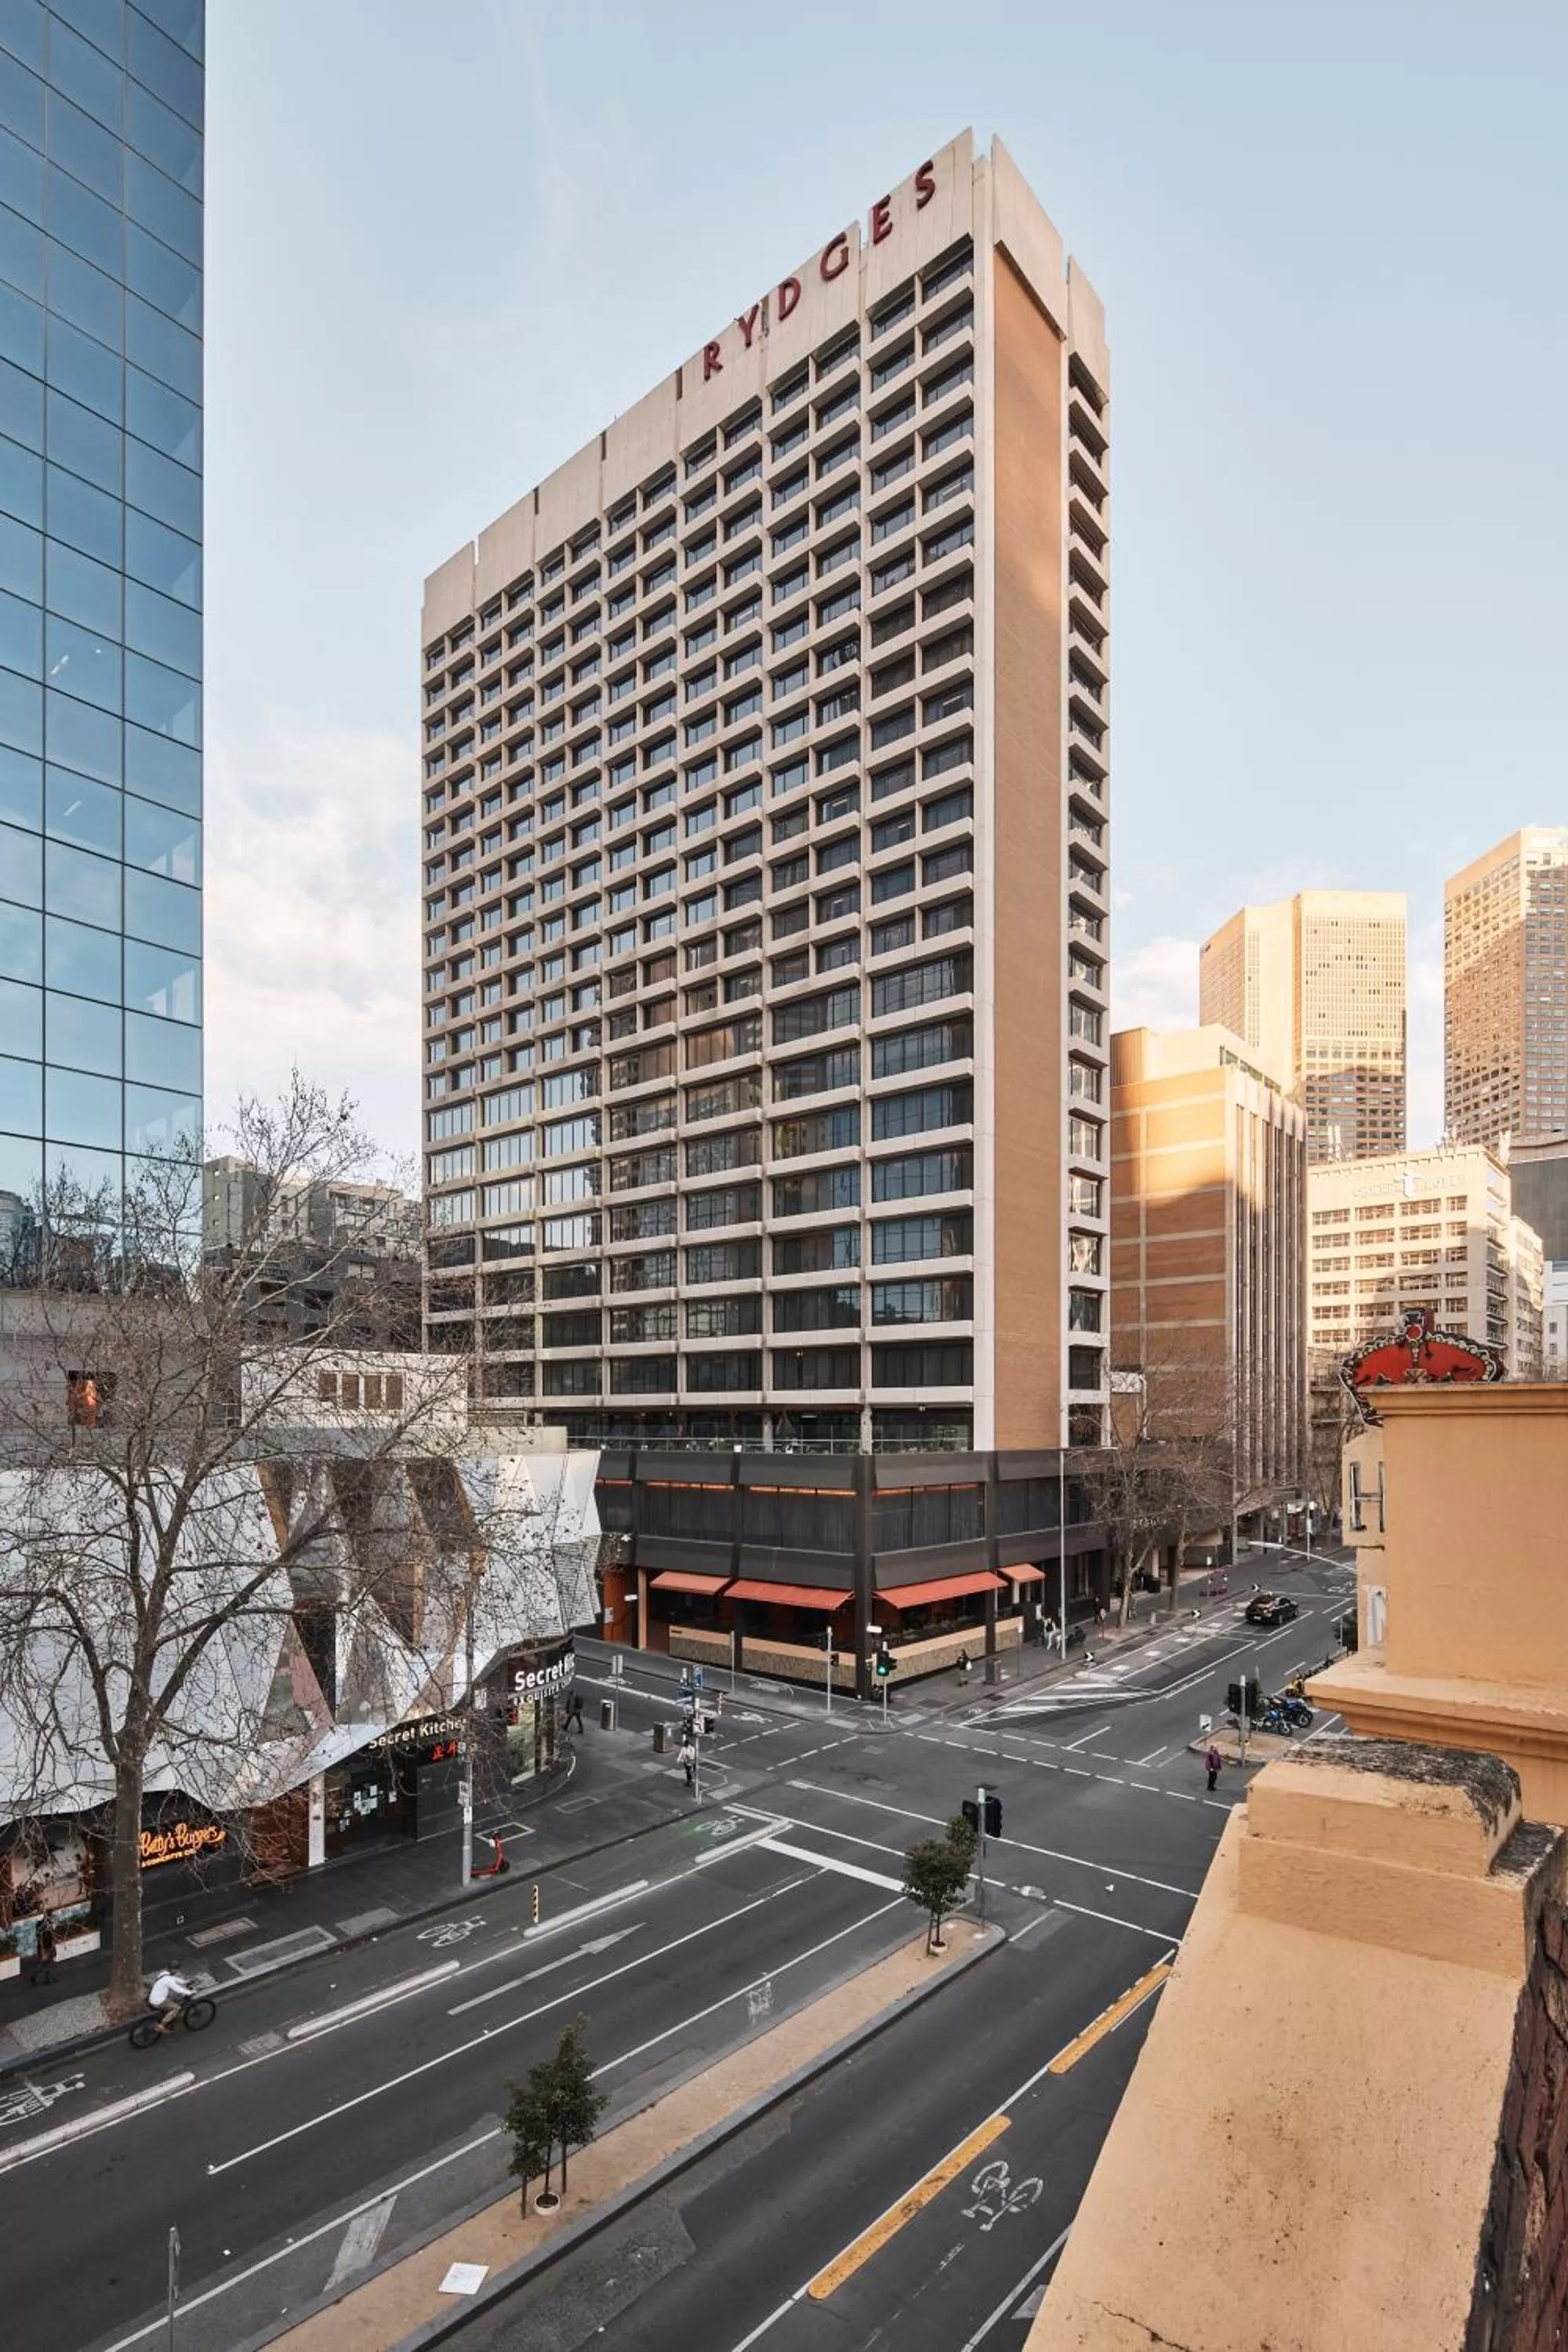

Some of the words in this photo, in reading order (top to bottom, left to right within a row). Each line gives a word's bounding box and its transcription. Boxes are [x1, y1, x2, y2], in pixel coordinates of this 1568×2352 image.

[703, 158, 936, 382] RYDGES
[514, 1660, 564, 1691] Secret
[368, 1727, 416, 1749] Secret
